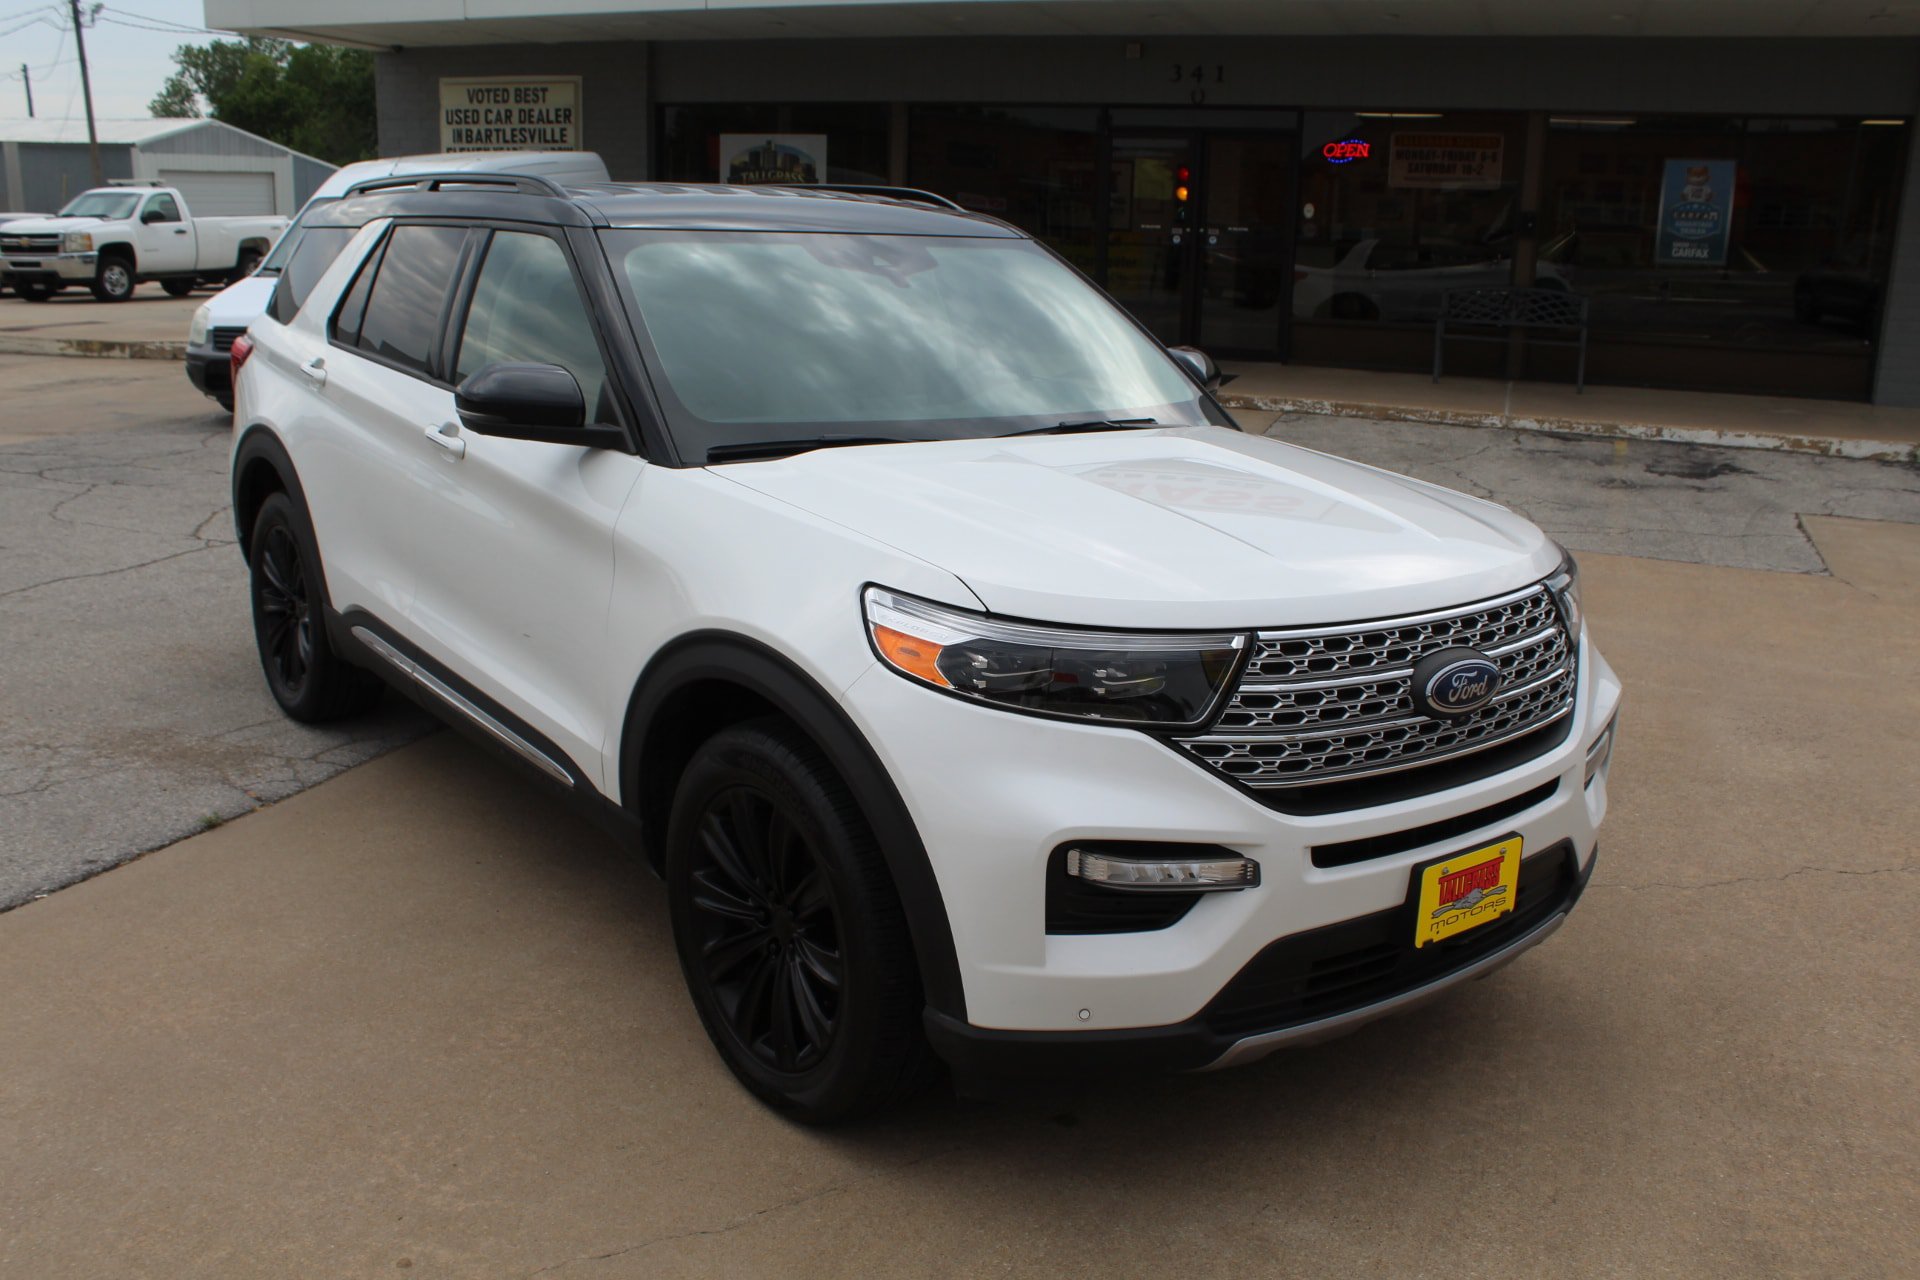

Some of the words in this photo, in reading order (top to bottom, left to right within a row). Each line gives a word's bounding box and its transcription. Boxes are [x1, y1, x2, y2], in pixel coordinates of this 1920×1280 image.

[1170, 63, 1225, 83] 341
[466, 88, 510, 104] VOTED
[514, 87, 548, 103] BEST
[446, 109, 479, 125] USED
[484, 109, 513, 124] CAR
[518, 108, 572, 124] DEALER
[452, 129, 463, 144] IN
[465, 127, 568, 144] BARTLESVILLE
[1322, 143, 1370, 158] OPEN
[1671, 247, 1709, 259] CARFAX
[1448, 671, 1488, 703] Ford
[1430, 896, 1506, 932] MOTORS
